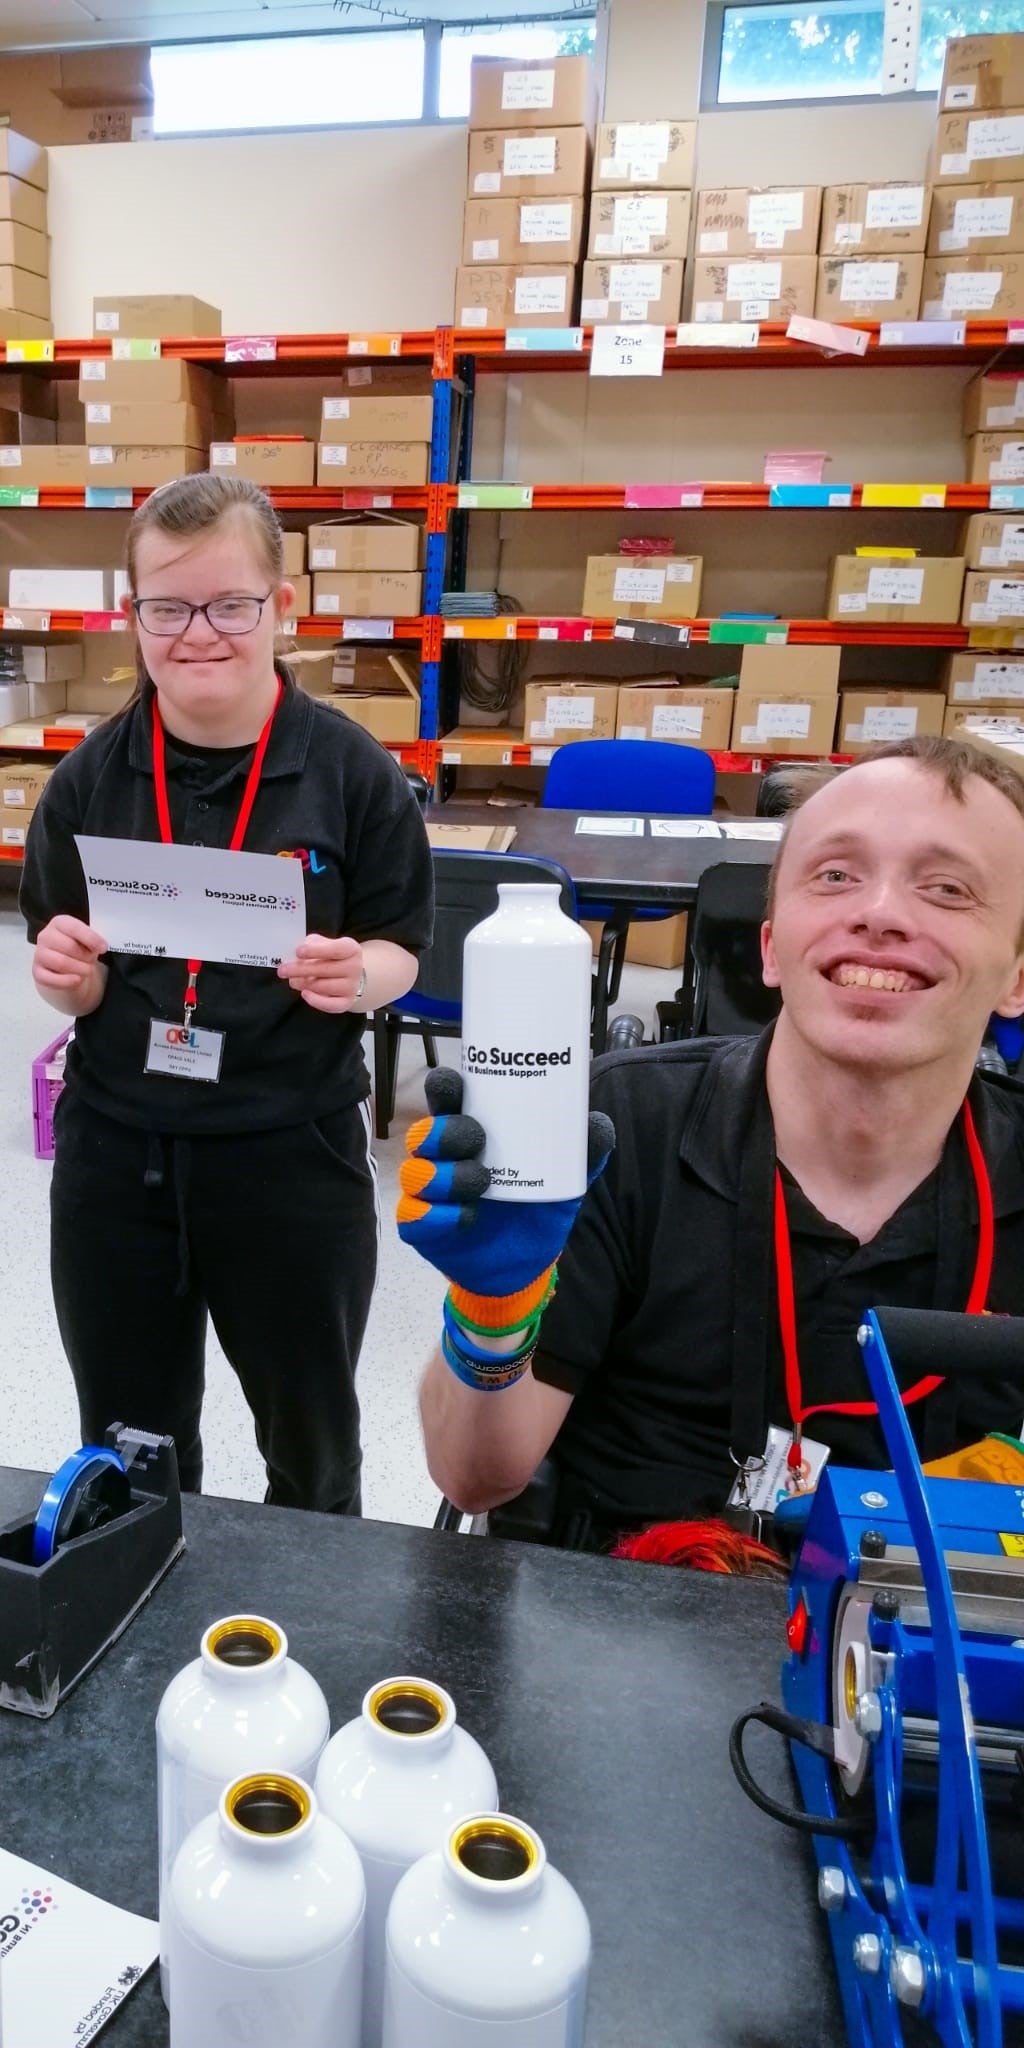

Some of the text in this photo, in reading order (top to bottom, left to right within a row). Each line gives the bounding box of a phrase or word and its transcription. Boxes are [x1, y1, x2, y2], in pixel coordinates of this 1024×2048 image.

[614, 335, 643, 347] Zone
[619, 354, 633, 365] 15
[467, 1045, 571, 1066] Go Succeed
[474, 1066, 507, 1076] Business
[508, 1068, 547, 1078] Support
[507, 1168, 519, 1178] by
